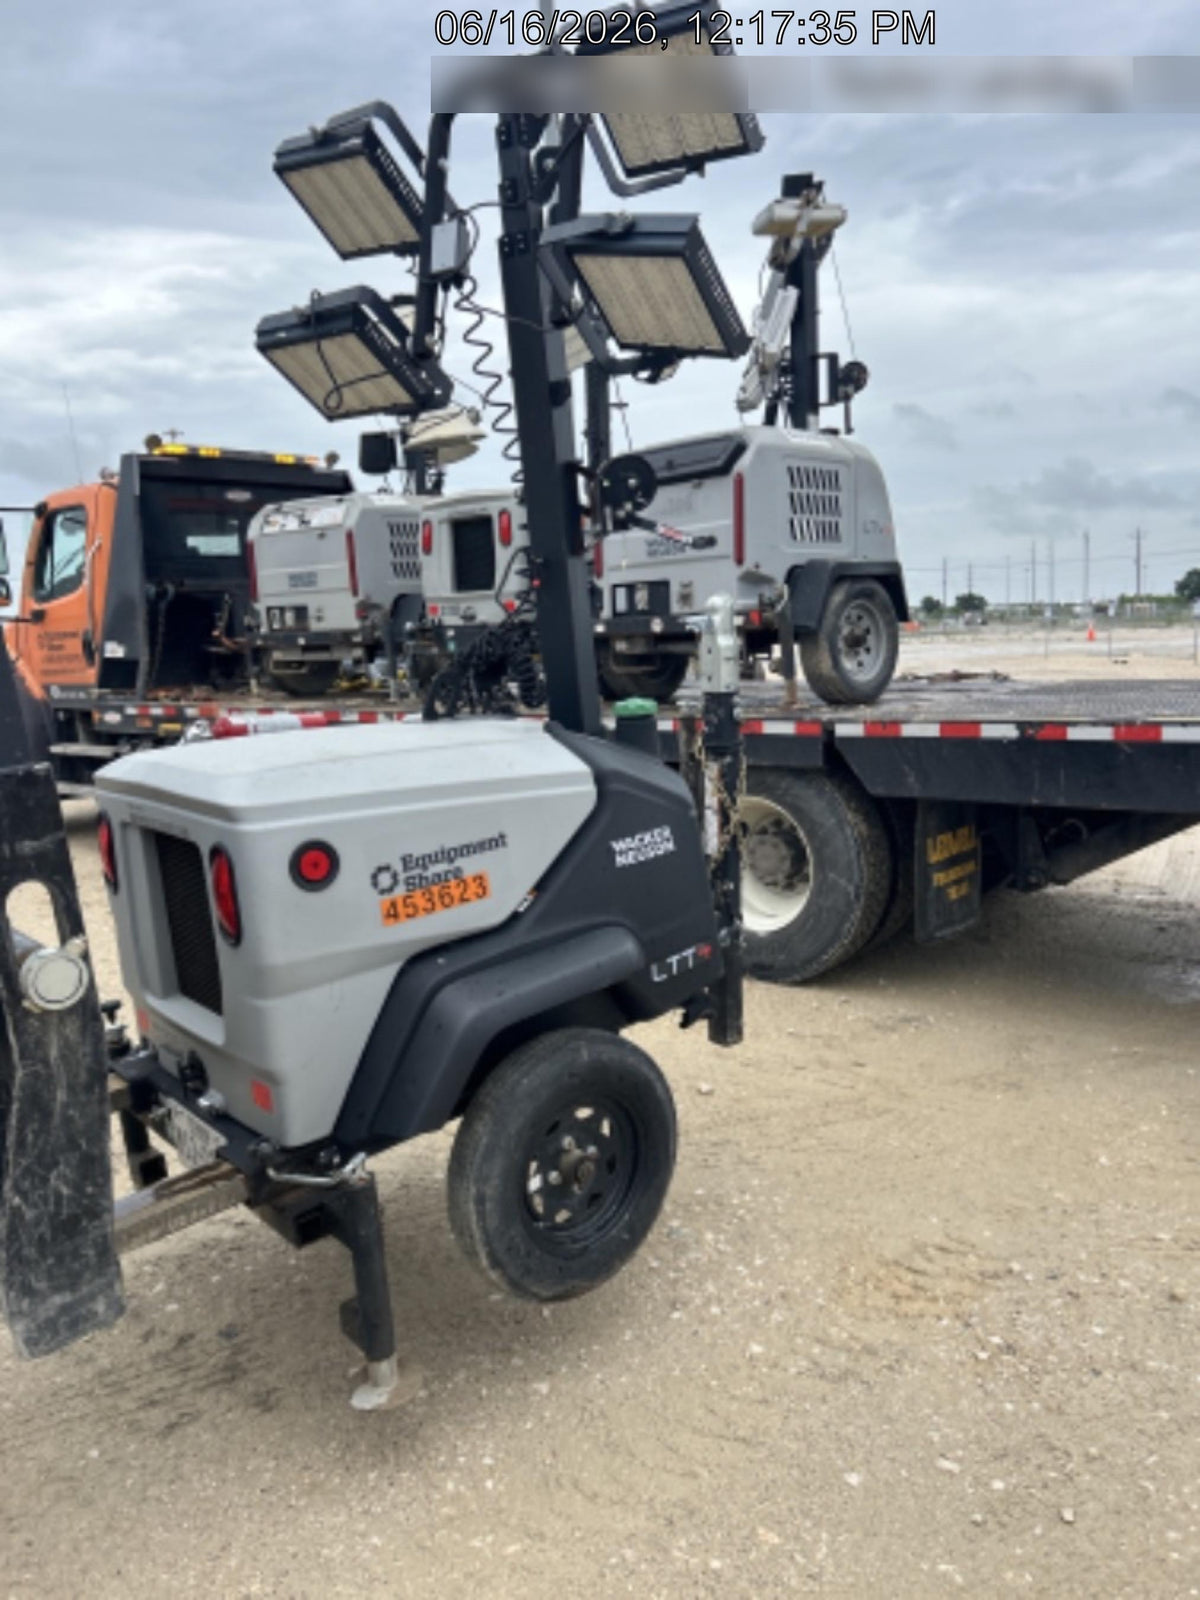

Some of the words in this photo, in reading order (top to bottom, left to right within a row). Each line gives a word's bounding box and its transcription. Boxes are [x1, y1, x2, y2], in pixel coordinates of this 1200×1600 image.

[400, 831, 507, 873] Equipment
[384, 875, 488, 919] 453623
[404, 866, 463, 892] Share
